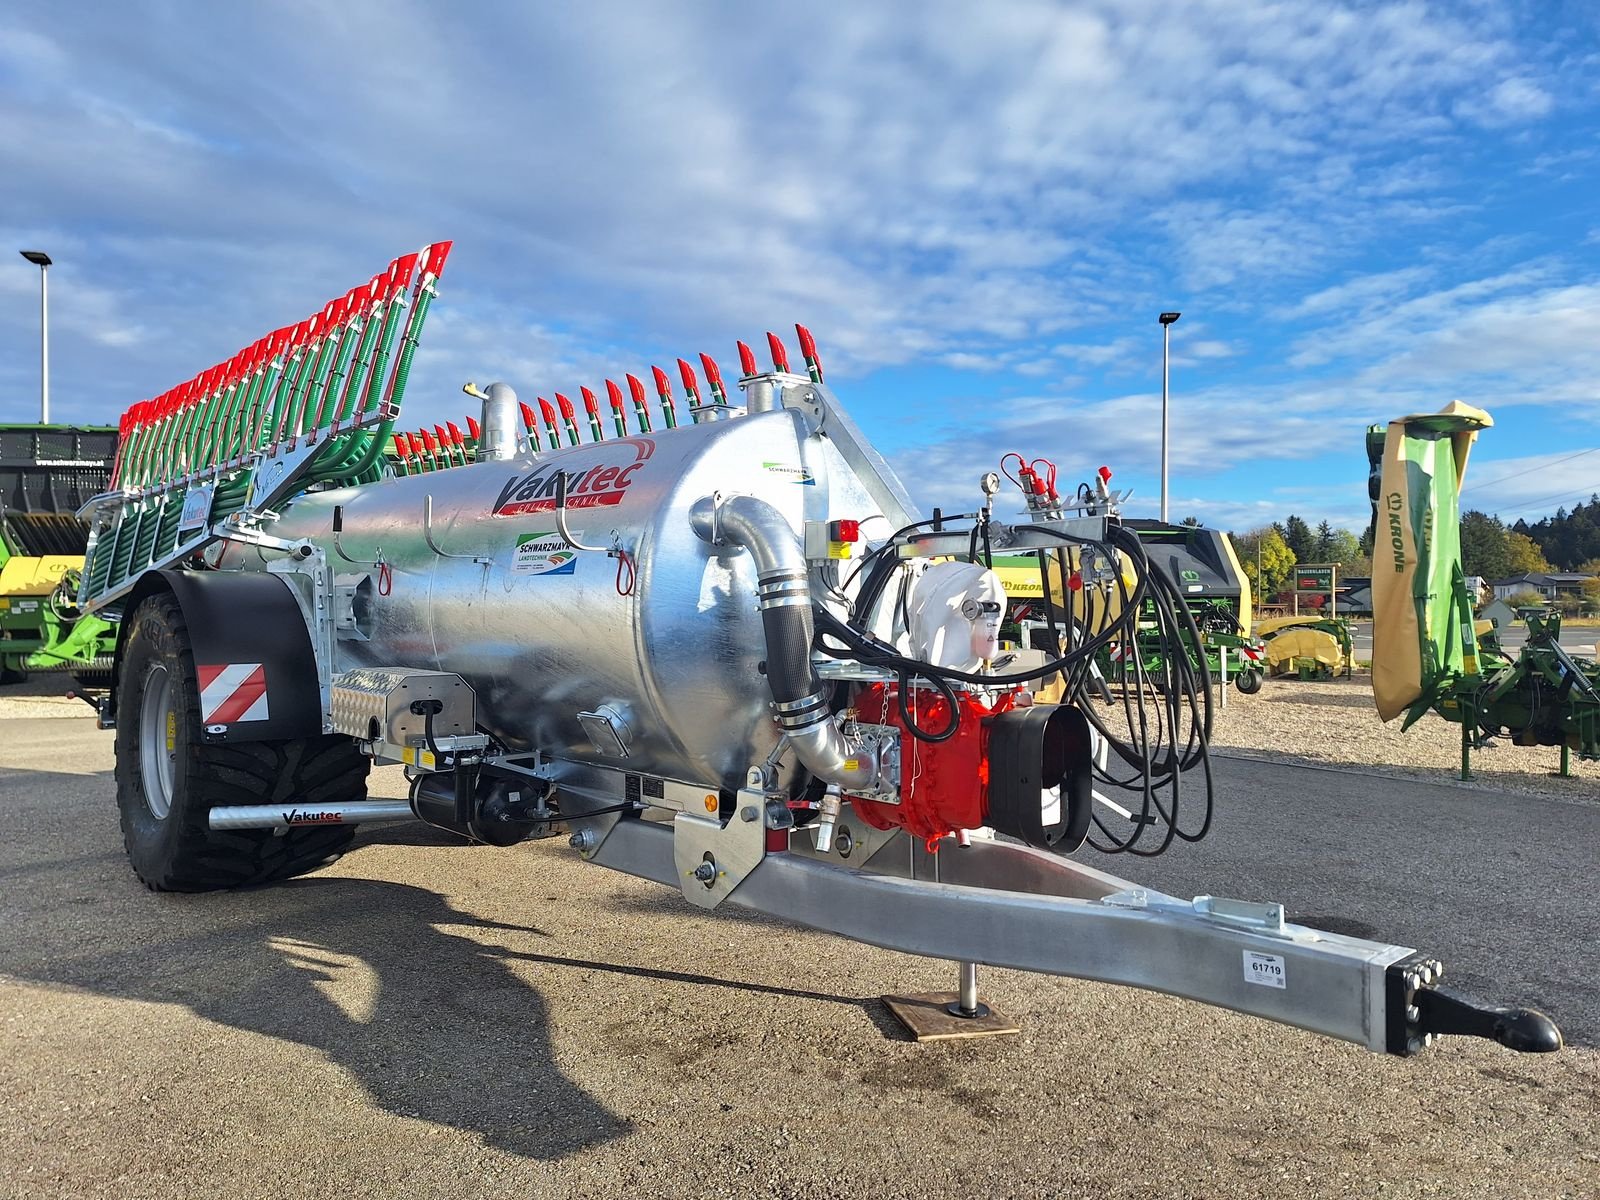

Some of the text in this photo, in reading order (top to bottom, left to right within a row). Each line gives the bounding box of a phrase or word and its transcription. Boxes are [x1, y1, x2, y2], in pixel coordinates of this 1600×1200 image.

[492, 463, 644, 516] Vakutec
[520, 542, 570, 553] SCHWARZMAYR
[1389, 513, 1405, 573] KRONE
[282, 809, 342, 824] Vakutec
[1252, 962, 1281, 975] 61719
